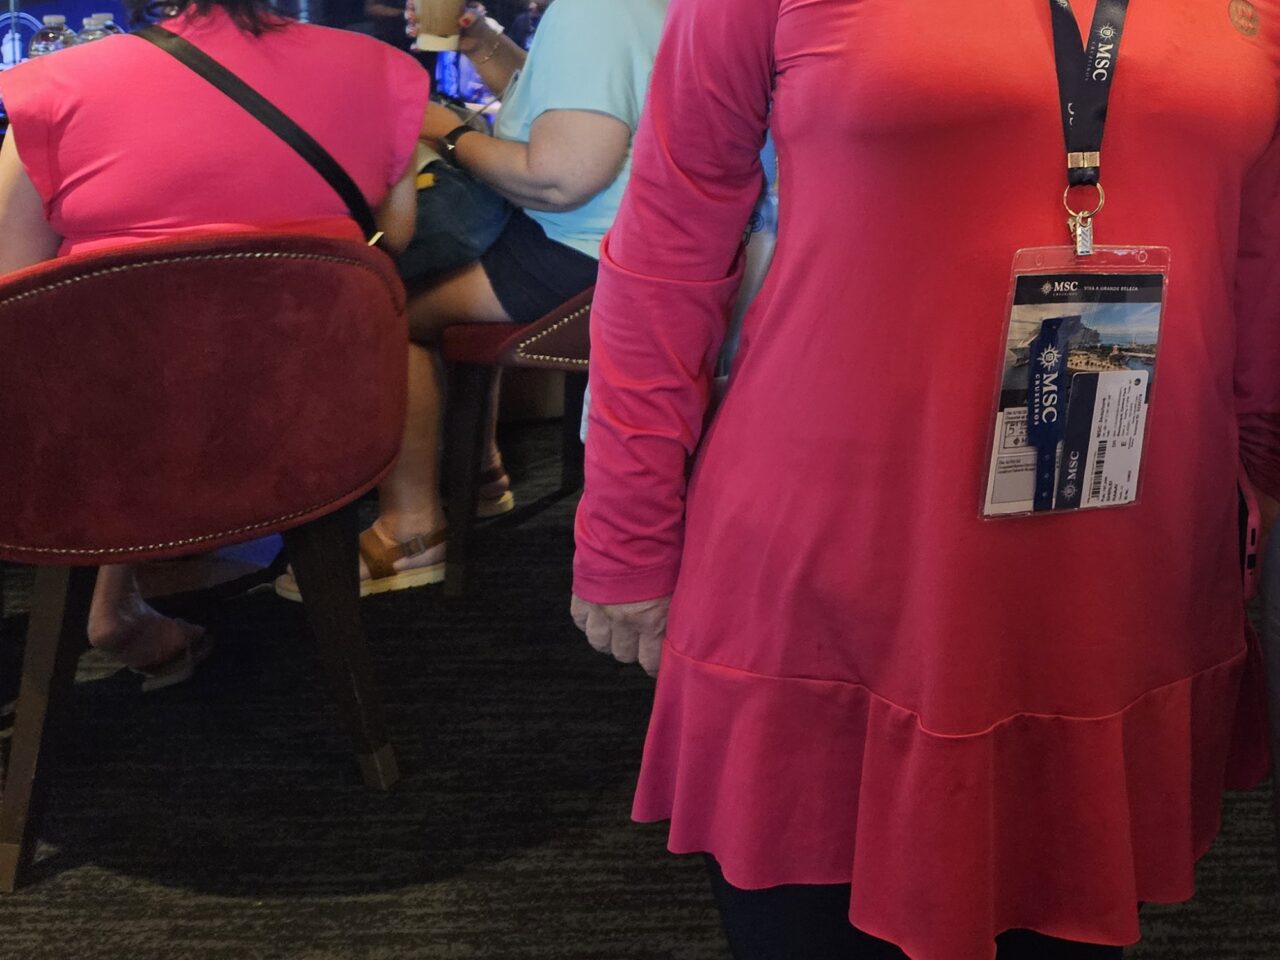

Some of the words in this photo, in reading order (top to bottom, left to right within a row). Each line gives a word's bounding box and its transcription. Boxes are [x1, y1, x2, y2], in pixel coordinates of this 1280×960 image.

[1092, 43, 1114, 81] MSC
[1053, 281, 1078, 291] MSC
[1042, 371, 1058, 423] MSC
[1067, 451, 1079, 480] MSC
